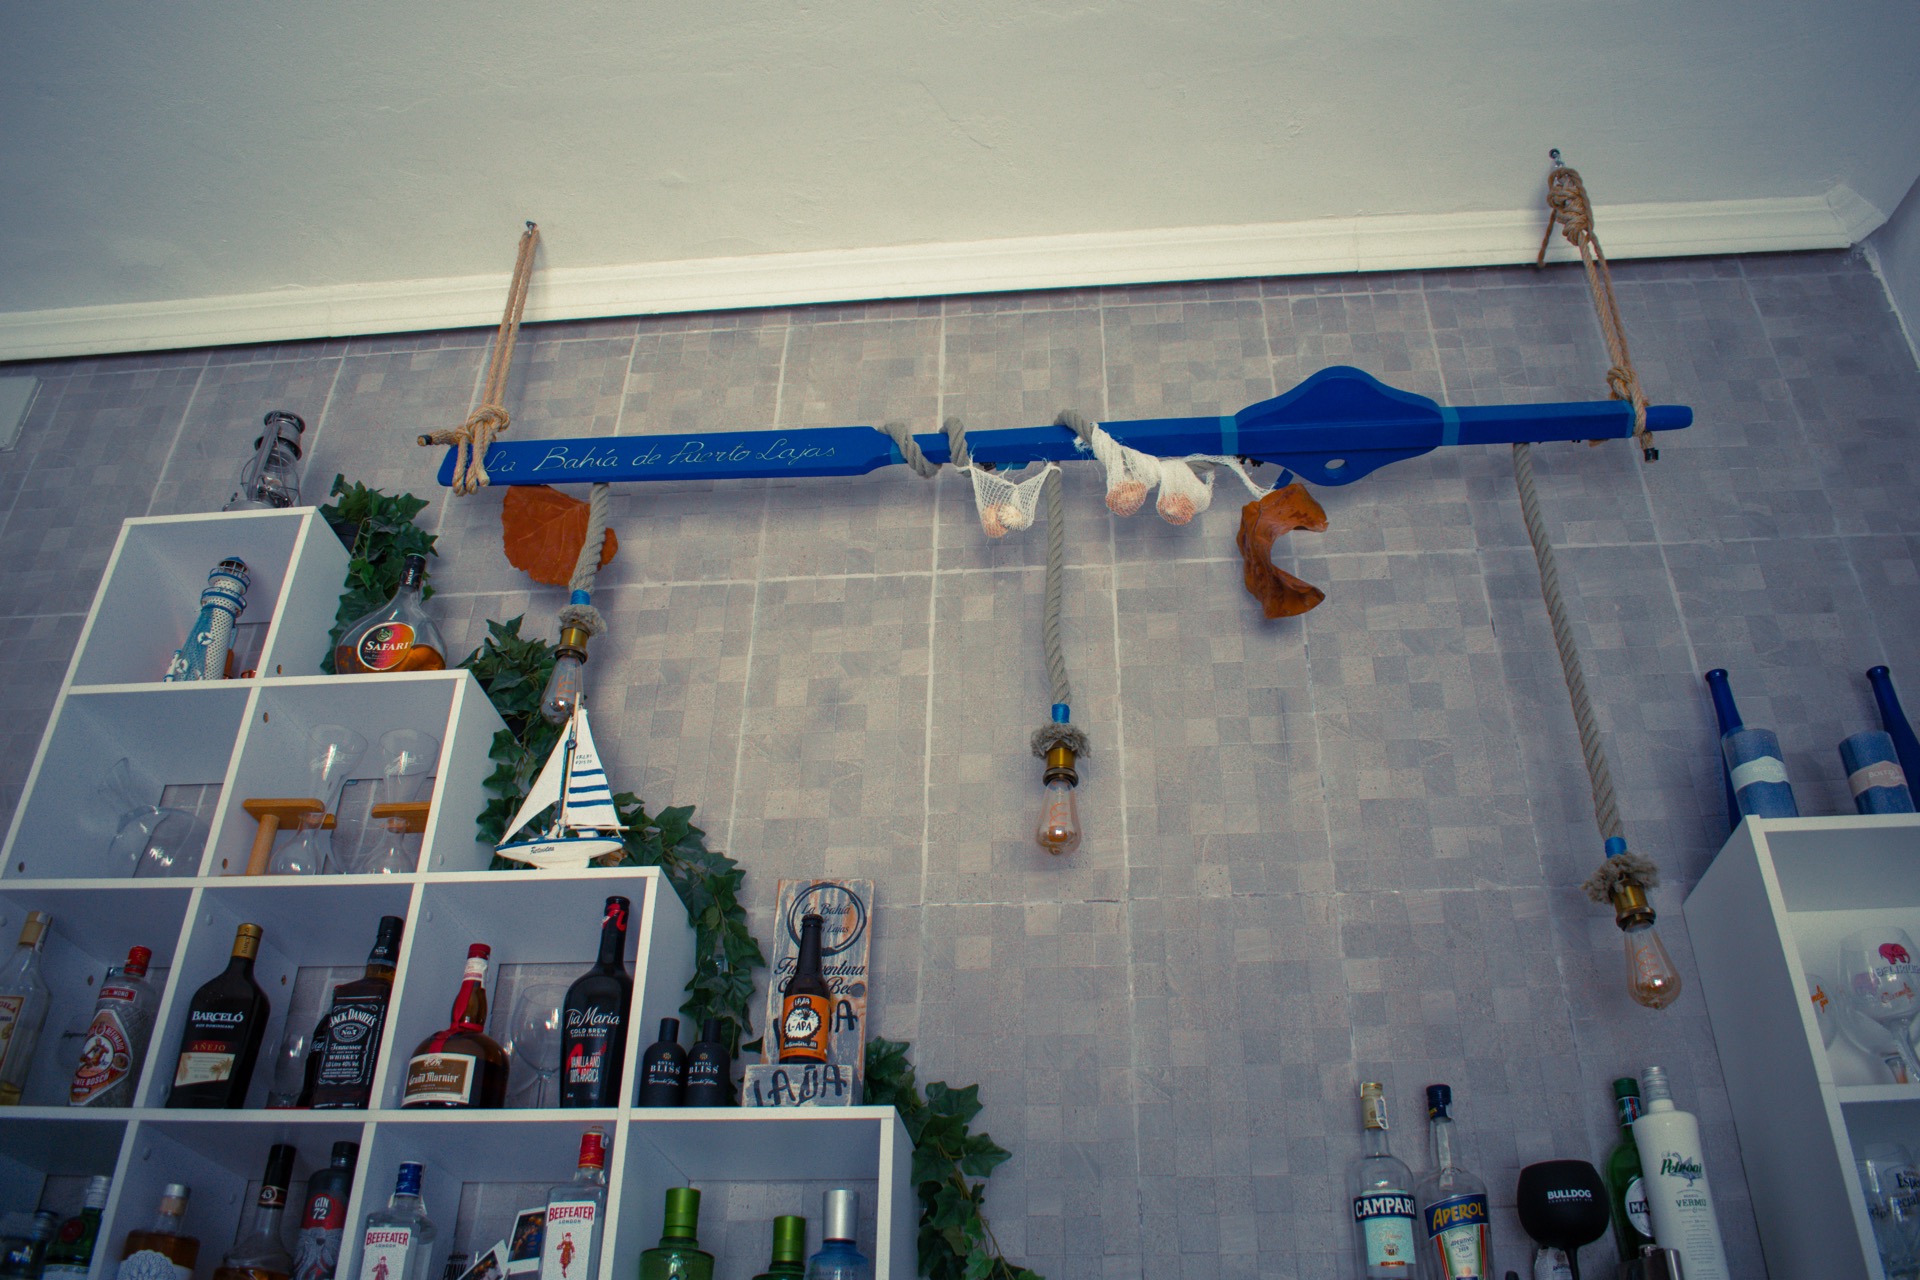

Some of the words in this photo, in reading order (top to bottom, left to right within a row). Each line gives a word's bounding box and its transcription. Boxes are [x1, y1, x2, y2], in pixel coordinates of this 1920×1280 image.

[484, 450, 516, 472] La
[532, 446, 618, 472] Bahía
[632, 443, 661, 466] de
[667, 440, 752, 465] Puerto
[755, 438, 835, 465] Lajas
[365, 641, 409, 651] SAFARI
[801, 903, 816, 914] La
[191, 1010, 244, 1023] BARCELÓ
[329, 1011, 348, 1028] JACK
[566, 1008, 582, 1029] Tia
[581, 1006, 621, 1026] Maria
[787, 1021, 812, 1032] L-APA
[193, 1042, 226, 1052] AÑEJO
[650, 1064, 680, 1075] BLISS
[688, 1064, 719, 1074] BLISS
[409, 1072, 426, 1086] Grand
[426, 1070, 460, 1083] Marnier
[261, 1189, 272, 1199] 43
[1547, 1188, 1592, 1200] BULLDOG
[314, 1196, 330, 1208] GIN
[1355, 1196, 1416, 1218] CAMPARI
[312, 1207, 328, 1220] 72
[549, 1206, 595, 1222] BEEFEATER
[1432, 1202, 1484, 1231] APEROL
[366, 1231, 409, 1246] BEEFEATER
